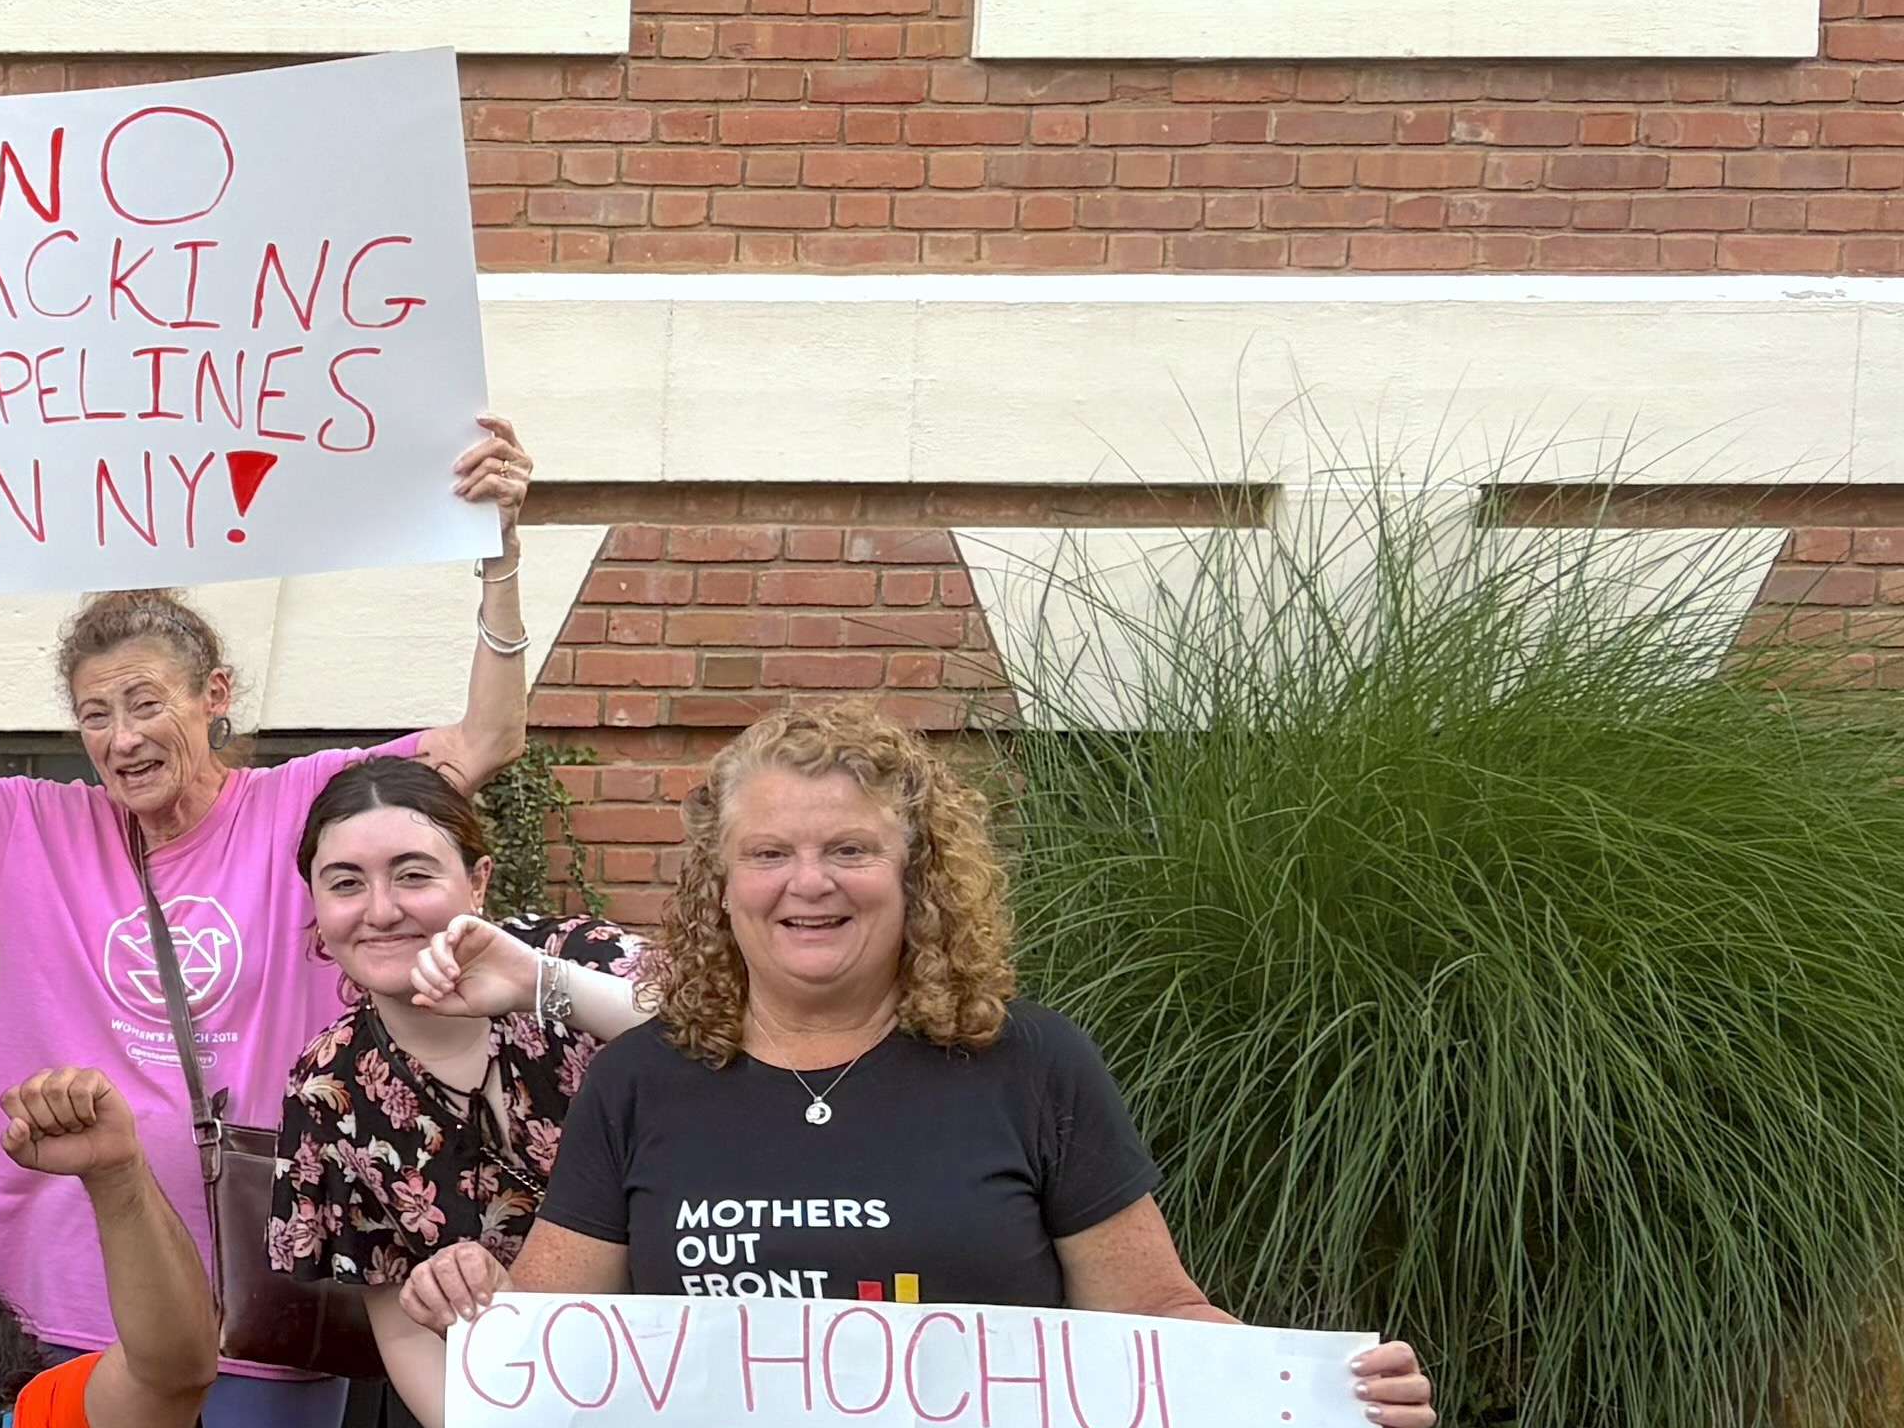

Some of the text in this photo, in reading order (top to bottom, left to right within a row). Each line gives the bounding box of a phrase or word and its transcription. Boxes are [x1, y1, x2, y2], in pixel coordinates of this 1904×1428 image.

[96, 449, 278, 549] NY!
[111, 1019, 239, 1043] WOMEN'S MCH 2018
[675, 1199, 891, 1230] MOTHERS
[676, 1233, 761, 1268] OUT
[681, 1270, 829, 1299] FRONT
[462, 1301, 690, 1411] GOV
